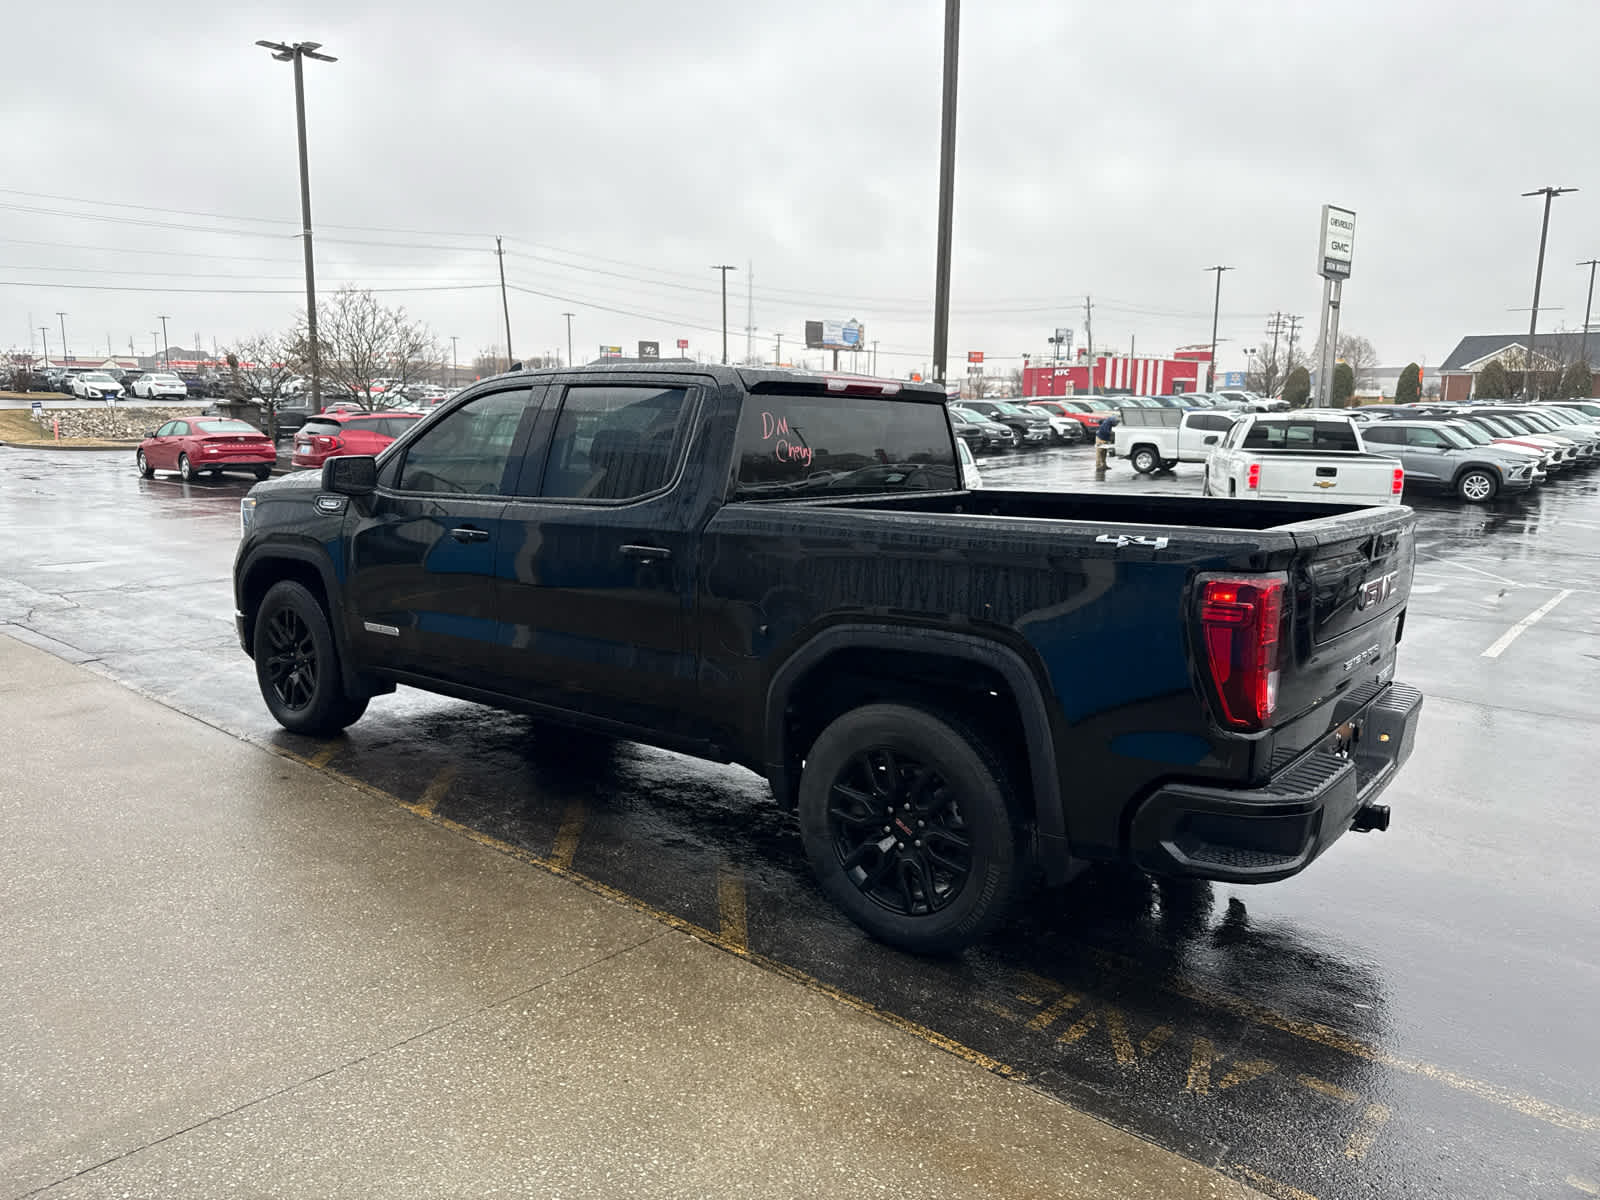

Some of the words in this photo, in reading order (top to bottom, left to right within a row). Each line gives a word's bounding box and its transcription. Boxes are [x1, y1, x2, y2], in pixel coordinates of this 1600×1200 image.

[1331, 241, 1349, 253] GMC
[776, 439, 812, 467] Chevy
[1358, 570, 1398, 609] GMC
